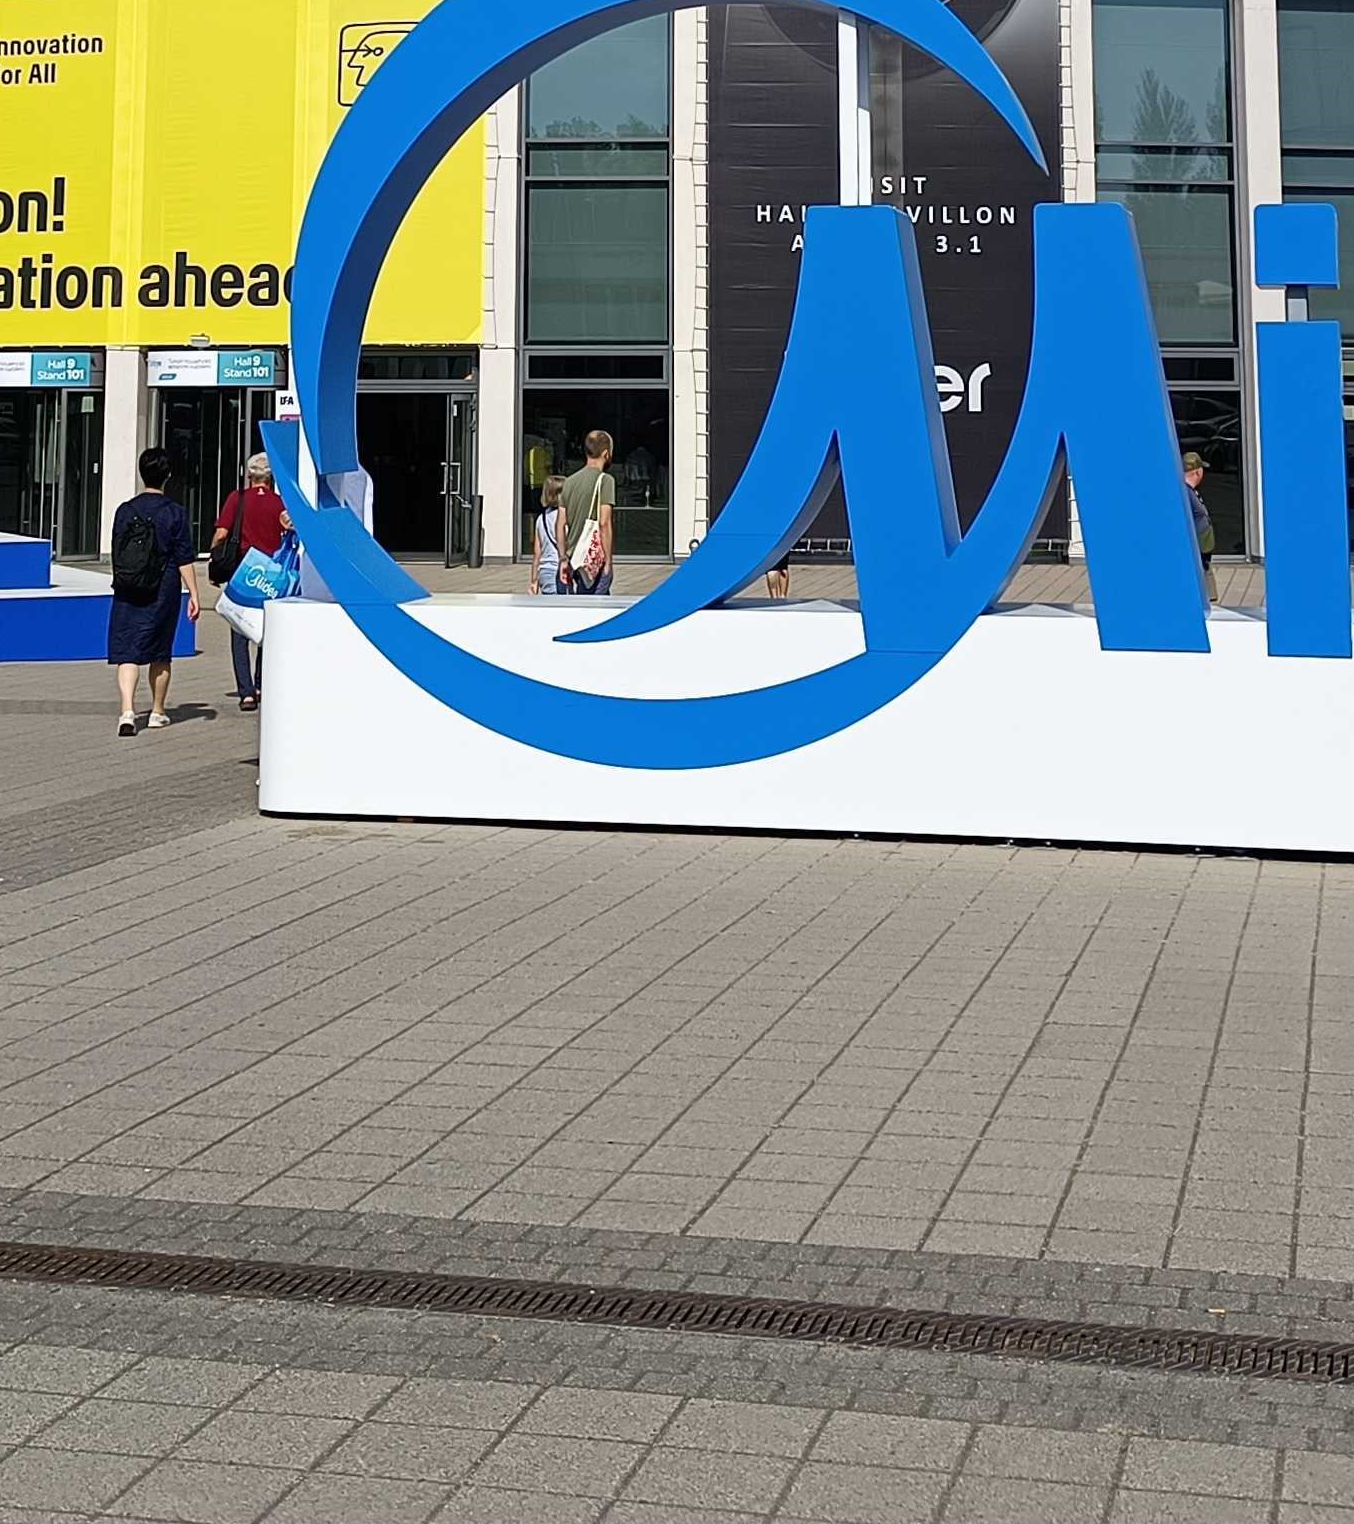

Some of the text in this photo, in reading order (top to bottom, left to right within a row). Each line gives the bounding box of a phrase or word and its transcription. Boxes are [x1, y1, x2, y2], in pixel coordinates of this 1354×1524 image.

[28, 63, 57, 85] All
[871, 176, 928, 195] SIT
[756, 204, 1016, 225] HAI VILLON
[791, 234, 983, 254] A 3.1
[138, 252, 293, 309] ahea
[47, 358, 76, 369] Hall 9
[233, 355, 261, 366] Hall 9
[36, 369, 85, 381] Stand 101
[223, 367, 269, 378] Stand 101
